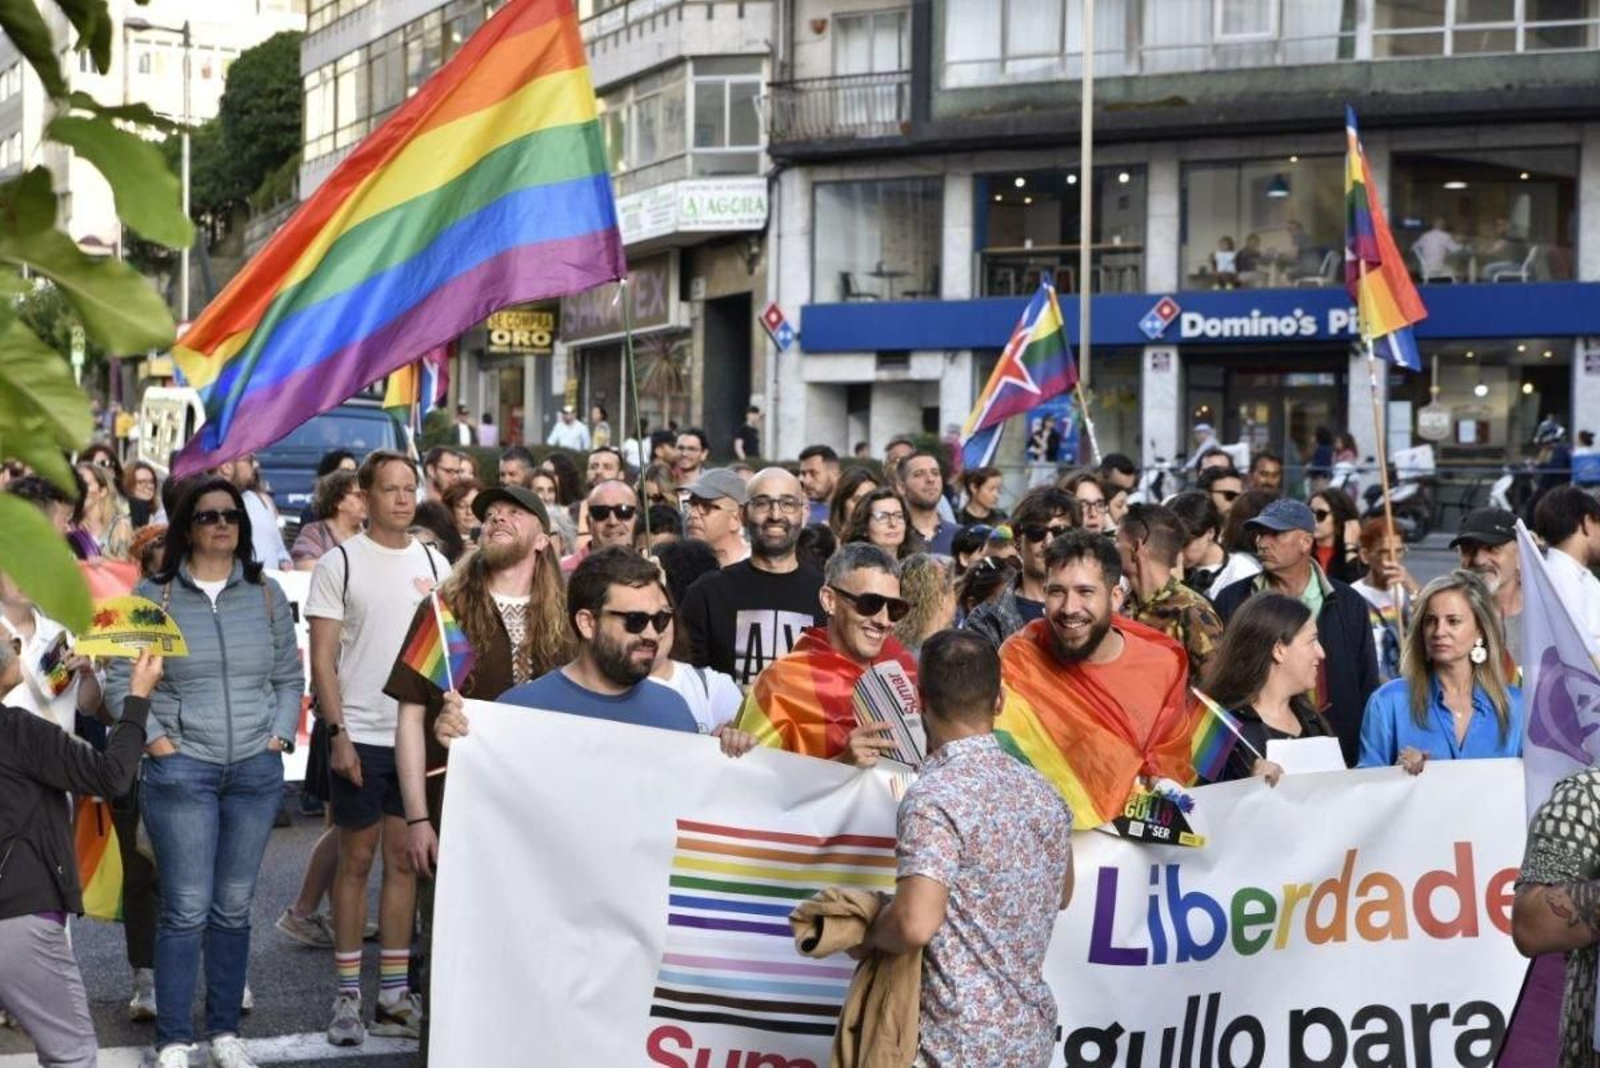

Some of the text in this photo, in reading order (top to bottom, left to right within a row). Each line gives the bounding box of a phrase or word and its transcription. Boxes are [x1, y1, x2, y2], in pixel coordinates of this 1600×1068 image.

[490, 329, 552, 347] ORO
[1180, 308, 1359, 338] Domino's Pi
[888, 672, 919, 715] Sumar
[1123, 799, 1174, 825] GULLO
[1152, 826, 1171, 839] SER
[1088, 842, 1522, 967] Liberdade
[1055, 992, 1504, 1068] gullo para
